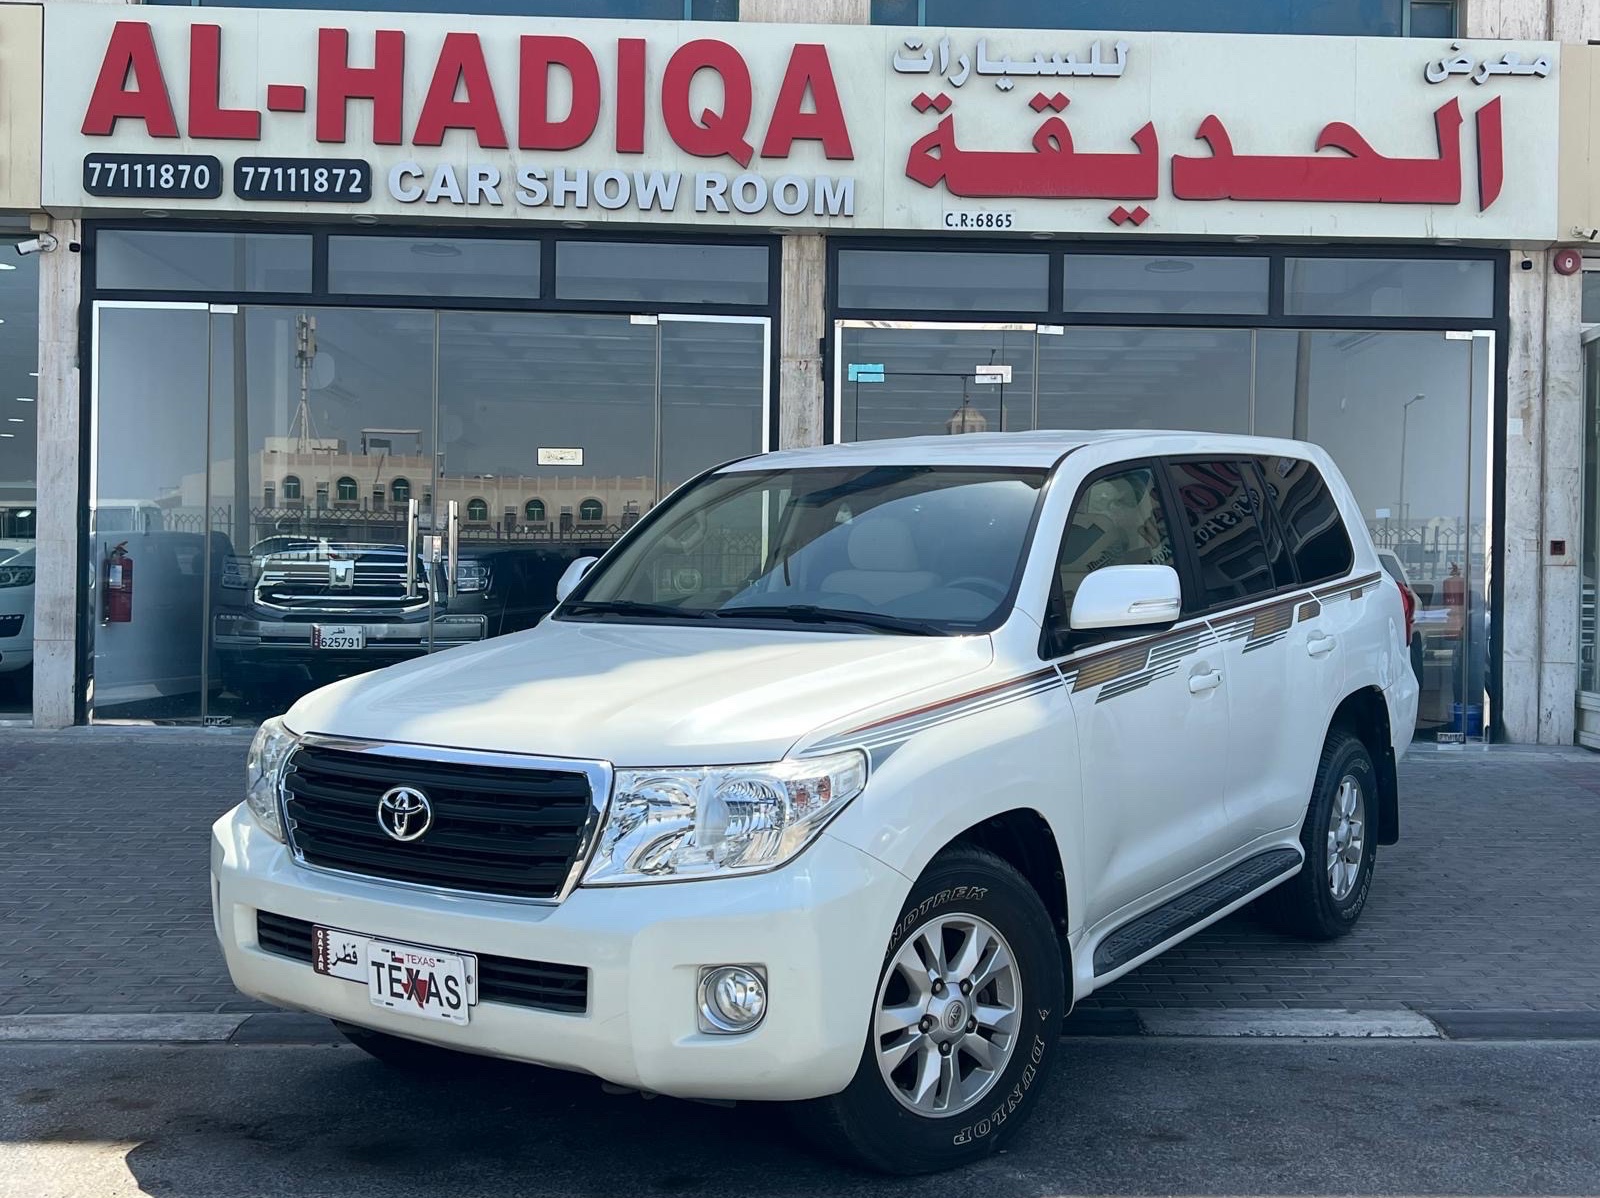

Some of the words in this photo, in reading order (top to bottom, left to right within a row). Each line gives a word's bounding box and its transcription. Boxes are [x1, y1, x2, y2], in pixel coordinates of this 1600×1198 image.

[893, 36, 1130, 92] للسيارات
[1424, 42, 1552, 86] معرض
[81, 21, 854, 168] AL-HADIQA
[88, 161, 211, 190] 77111870
[241, 166, 363, 194] 77111872
[905, 91, 1504, 227] الحديقة
[387, 161, 504, 206] CAR
[516, 167, 683, 212] SHOW
[694, 173, 856, 217] ROOM
[945, 213, 1012, 228] C.R:6865
[320, 637, 360, 648] 625791
[316, 930, 325, 971] QATAR
[330, 943, 358, 967] قطر
[405, 953, 436, 968] TEXAS
[371, 960, 461, 1010] TEXAS
[953, 1034, 1046, 1145] DUNLOP
